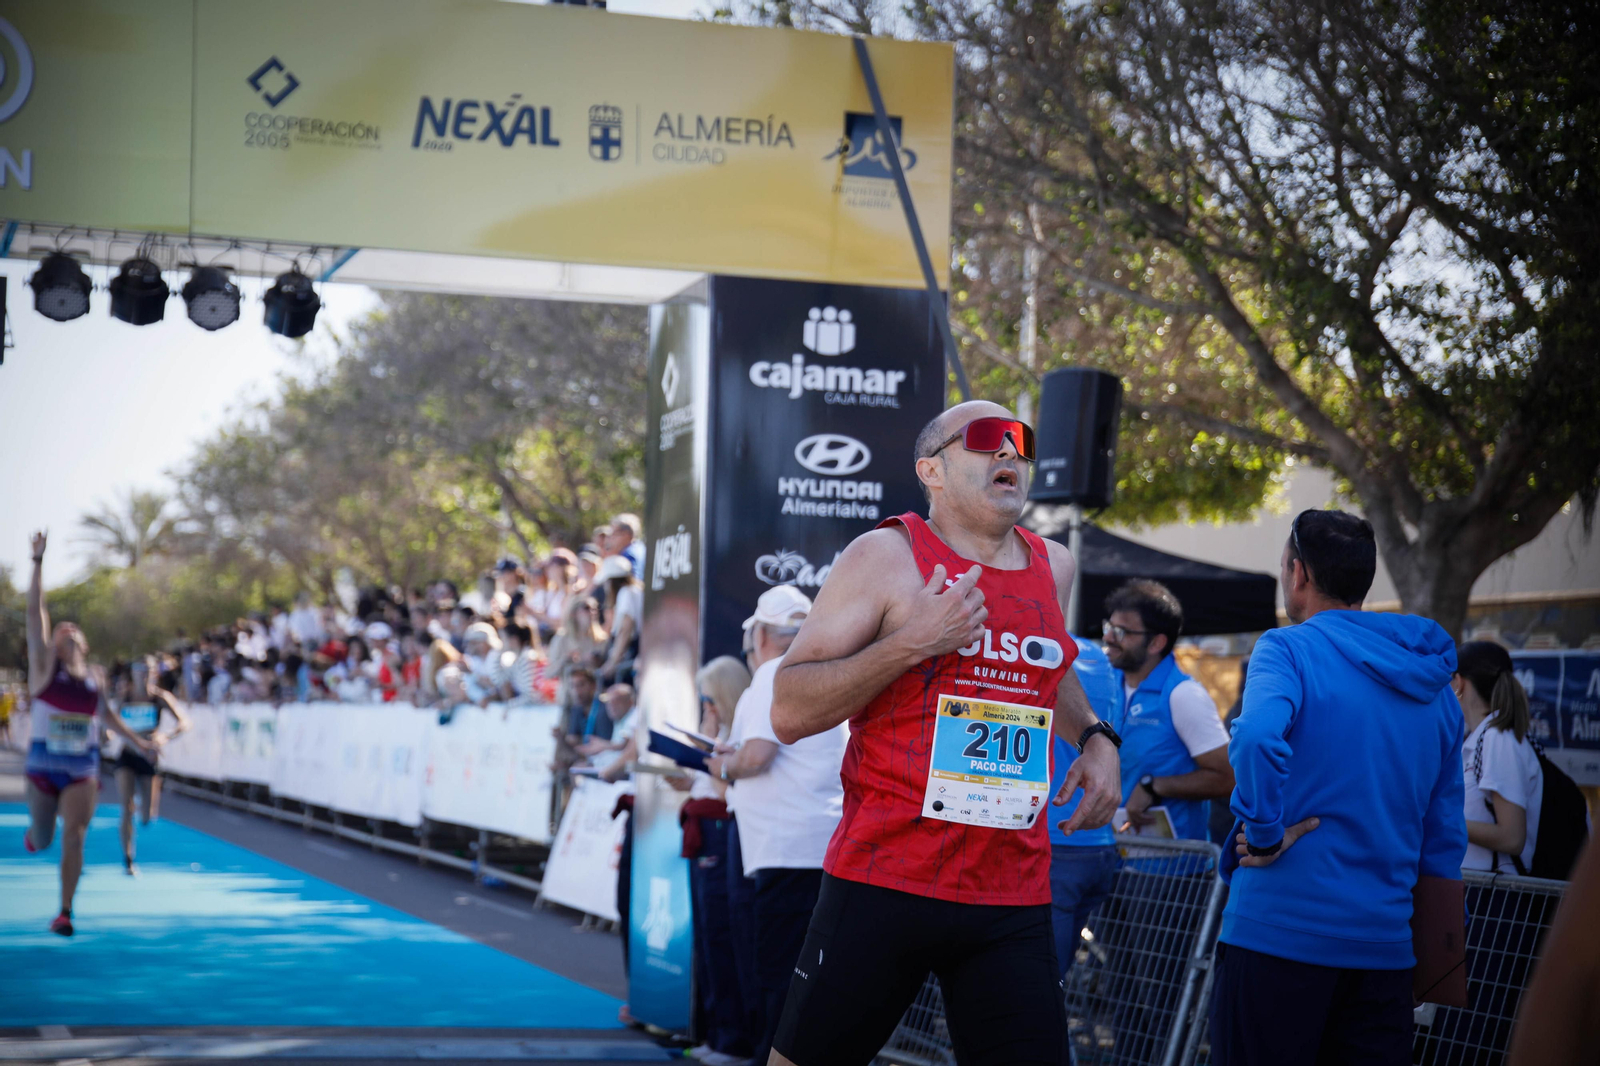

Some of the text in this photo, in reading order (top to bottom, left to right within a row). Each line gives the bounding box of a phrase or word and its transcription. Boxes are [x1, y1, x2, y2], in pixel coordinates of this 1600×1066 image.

[244, 112, 380, 141] COOPERACIÓN
[412, 93, 561, 148] NEXAL
[653, 112, 796, 149] ALMERÍA
[244, 129, 290, 150] 2005
[652, 142, 726, 165] CIUDAD
[749, 353, 906, 399] cajamar
[824, 392, 901, 409] CAJA RURAL
[778, 477, 883, 501] HYUNDAI
[974, 666, 1028, 684] RUNNING
[1006, 713, 1020, 722] 2024
[962, 721, 1031, 764] 210
[970, 760, 1023, 775] PACO CRUZ
[966, 793, 988, 802] NEXAL
